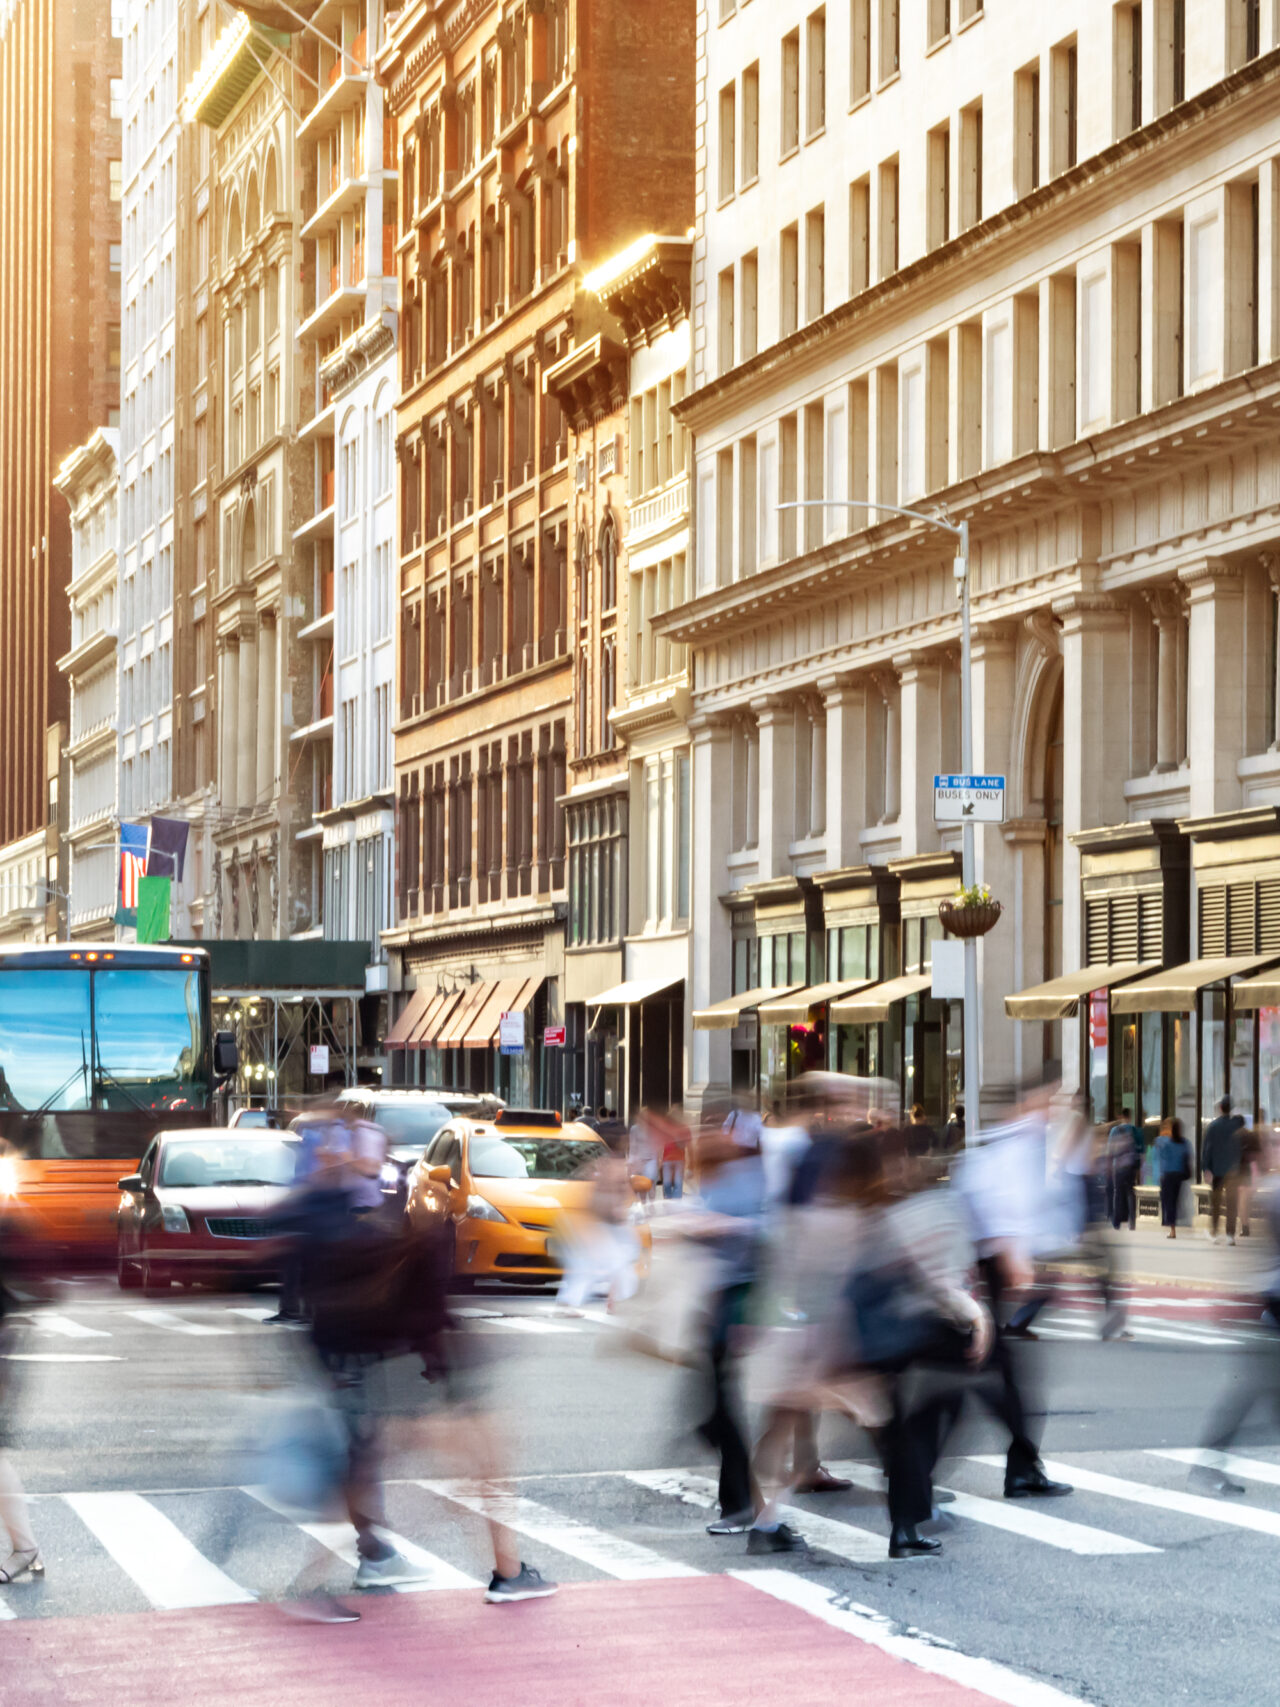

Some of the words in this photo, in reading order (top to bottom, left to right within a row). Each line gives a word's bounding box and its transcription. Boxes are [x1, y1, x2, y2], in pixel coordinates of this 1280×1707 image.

[953, 778, 971, 787] BUS
[974, 778, 1000, 788] LANE
[938, 790, 970, 800] BUSES
[975, 790, 1000, 800] ONLY
